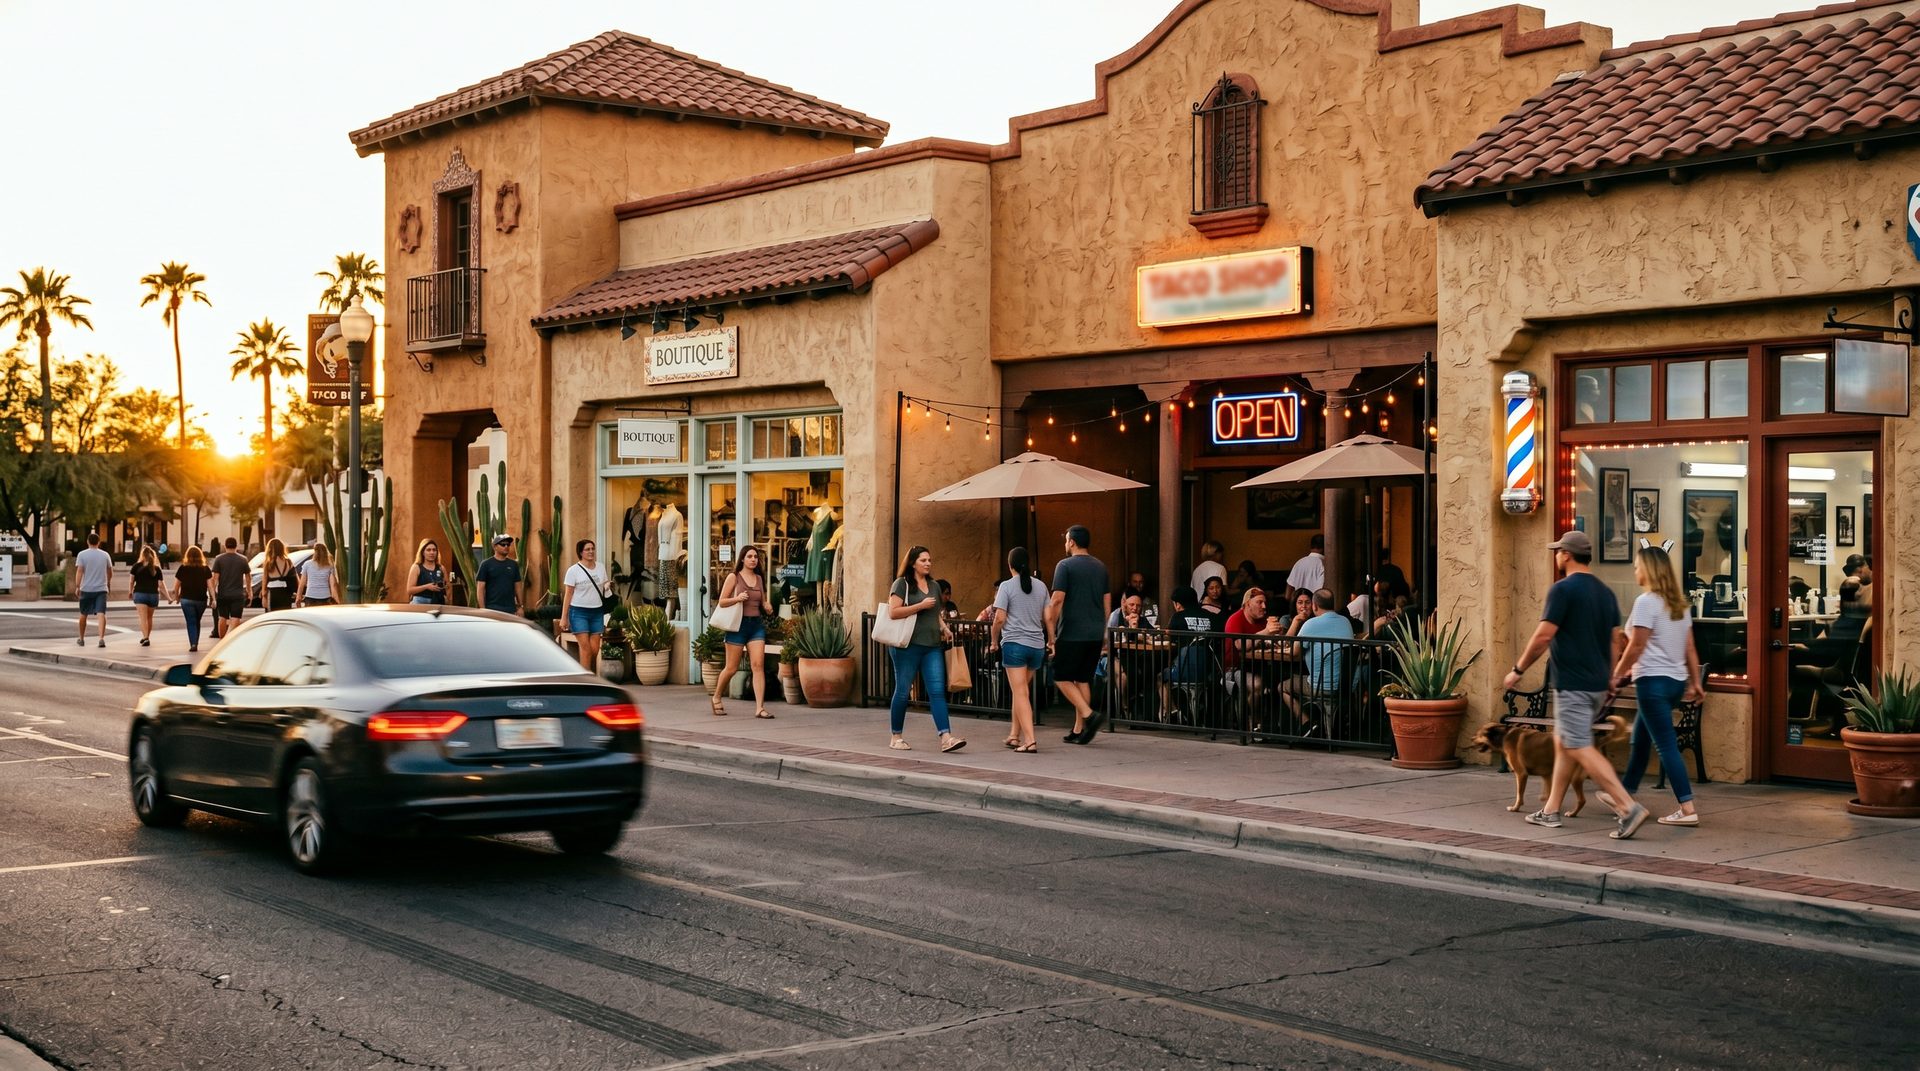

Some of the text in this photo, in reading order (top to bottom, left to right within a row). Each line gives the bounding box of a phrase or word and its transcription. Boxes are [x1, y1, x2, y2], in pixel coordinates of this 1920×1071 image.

[656, 341, 724, 367] BOUTIQUE
[312, 390, 337, 400] TACO
[1216, 397, 1294, 440] OPEN
[623, 432, 675, 445] BOUTIQUE
